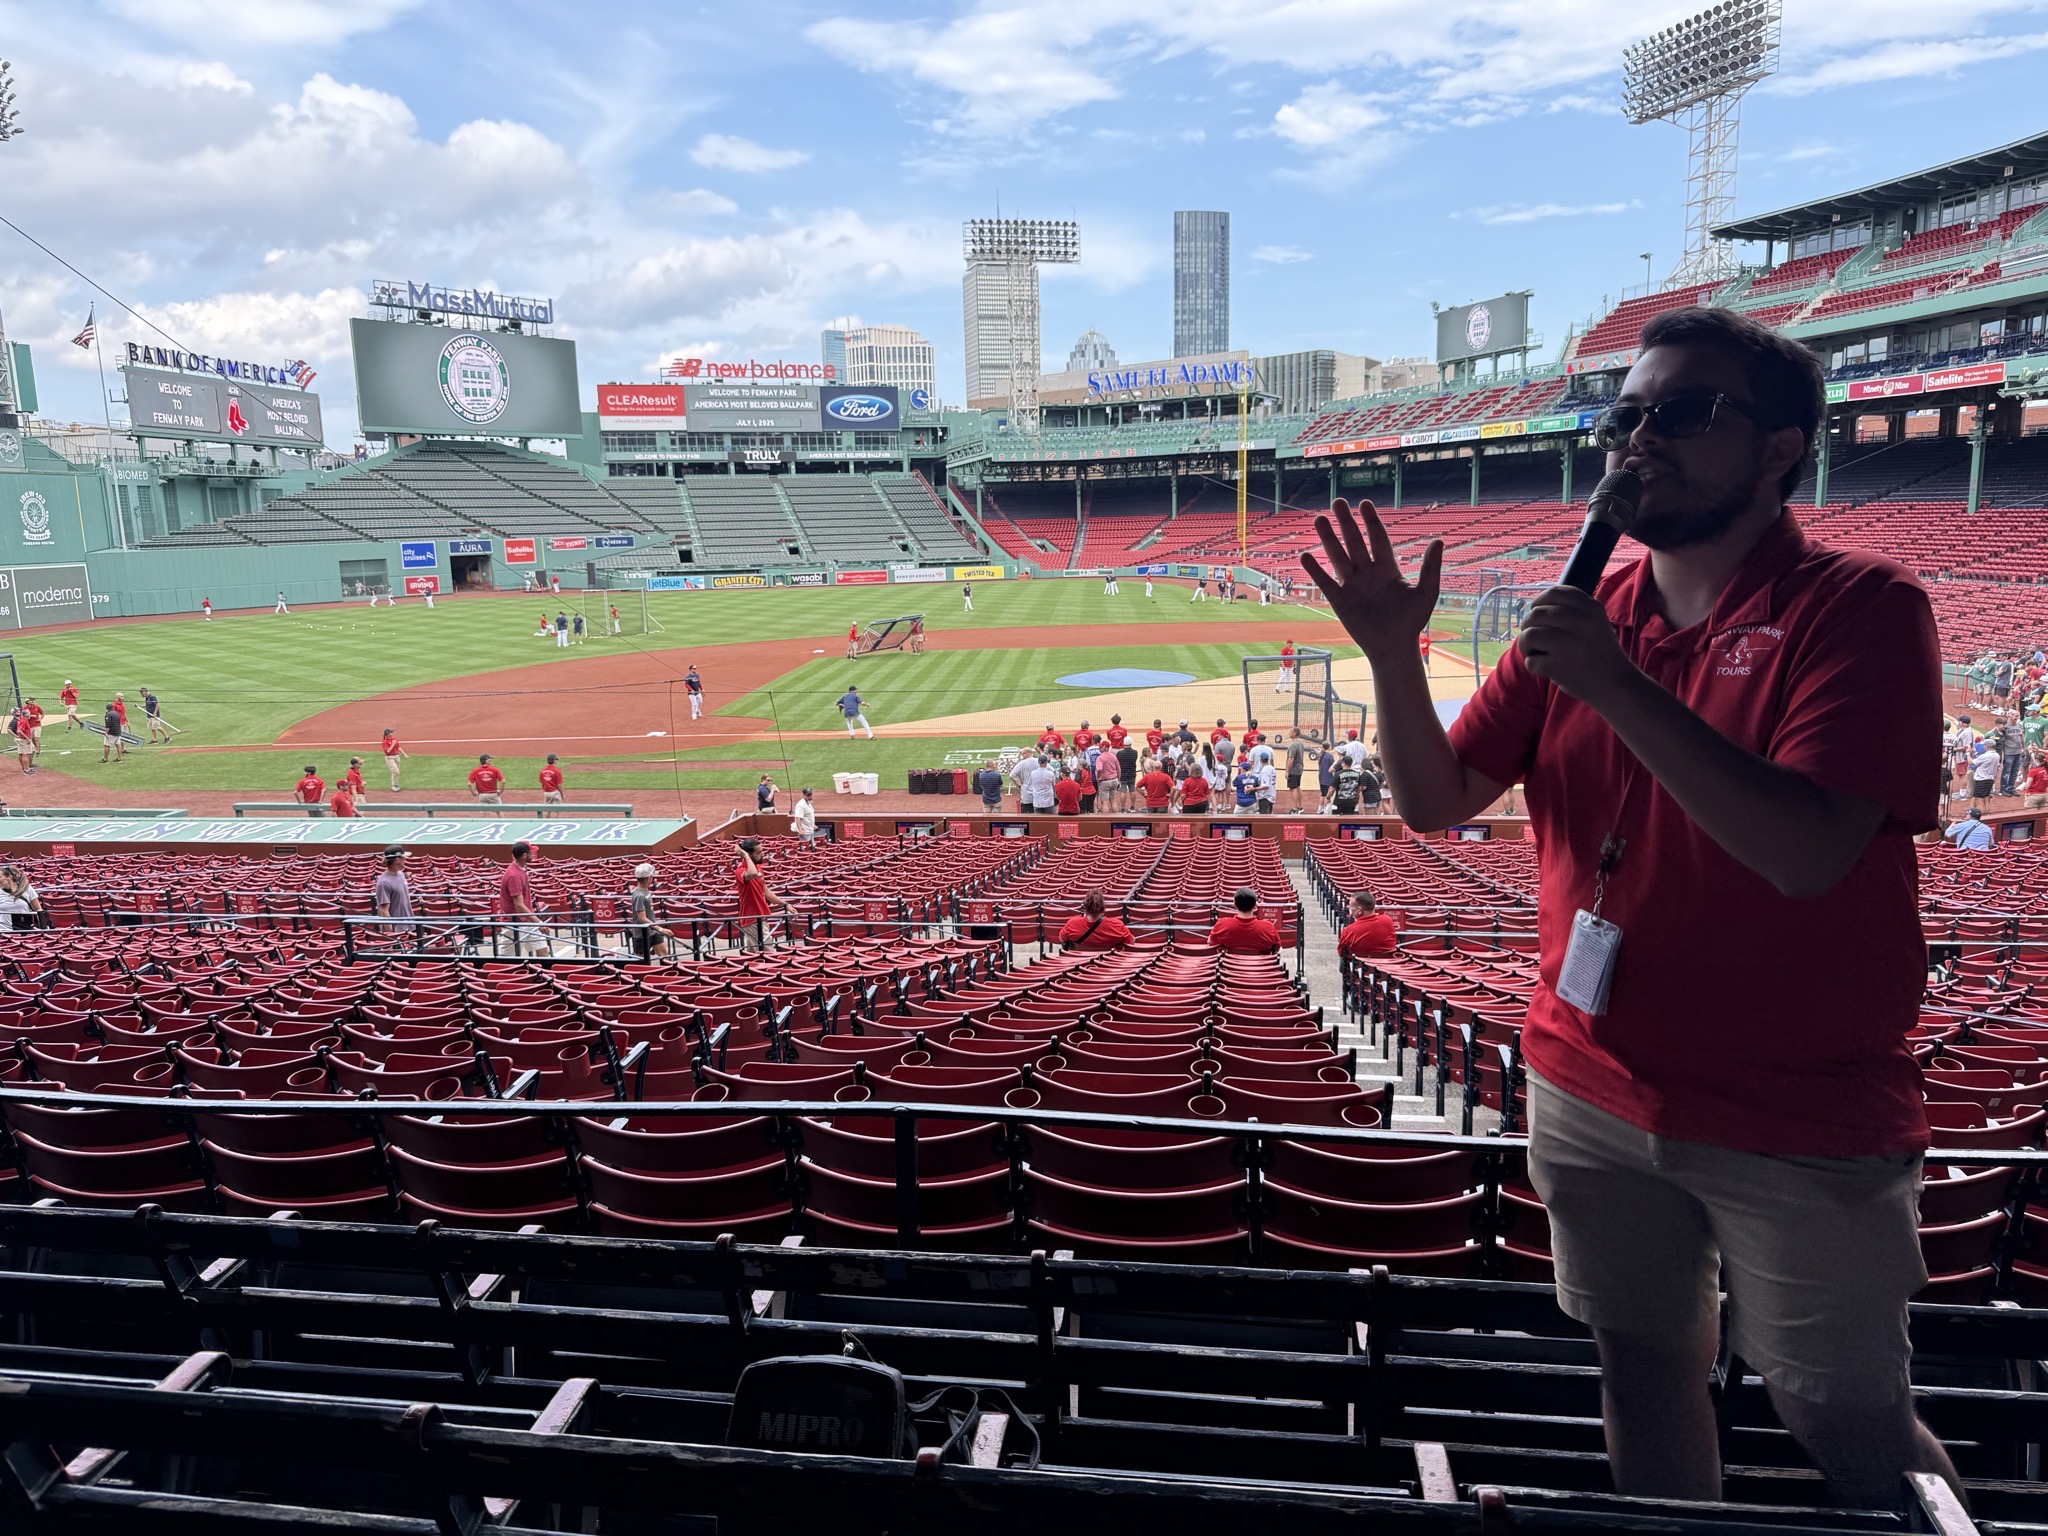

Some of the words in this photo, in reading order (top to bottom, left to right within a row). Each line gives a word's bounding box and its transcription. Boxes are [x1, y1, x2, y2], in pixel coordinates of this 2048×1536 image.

[408, 280, 554, 324] MassMutual
[444, 337, 478, 360] FENWAY
[481, 340, 502, 365] PARK
[128, 342, 182, 368] BANK
[188, 352, 209, 370] OF
[216, 358, 287, 384] AMERICA
[707, 363, 747, 378] new
[751, 359, 836, 379] balance
[1088, 368, 1174, 396] SAMUEL
[1176, 360, 1254, 384] ADAMS
[1928, 374, 1963, 387] Safelite
[159, 382, 192, 397] WELCOME
[1863, 385, 1883, 393] Ninety
[1895, 382, 1909, 390] Nine
[172, 399, 182, 410] TO
[272, 398, 301, 410] AMERICA'S
[442, 384, 455, 405] HOME
[463, 412, 475, 421] THE
[476, 410, 497, 421] BOSTON
[607, 395, 676, 405] CLEAResult
[840, 399, 879, 416] Ford
[154, 412, 184, 425] FENWAY
[186, 415, 204, 427] PARK
[267, 412, 283, 421] MOST
[284, 413, 308, 424] BELOVED
[275, 425, 304, 436] BALLPARK
[744, 451, 780, 460] TRULY
[20, 491, 34, 504] IBEW
[566, 540, 585, 548] TICKET
[792, 574, 822, 582] wasabi
[964, 570, 985, 578] TWISTED
[651, 579, 680, 589] jetBlue
[714, 576, 747, 587] GRANITE
[748, 576, 766, 586] CITY
[23, 586, 82, 603] moderna
[92, 595, 109, 603] 379
[1712, 626, 1758, 643] FWAY
[1758, 626, 1784, 640] PARK
[1716, 667, 1752, 676] TOURS
[14, 821, 391, 842] FENWAY
[394, 821, 650, 842] PARK
[758, 1412, 864, 1446] MIPRO
